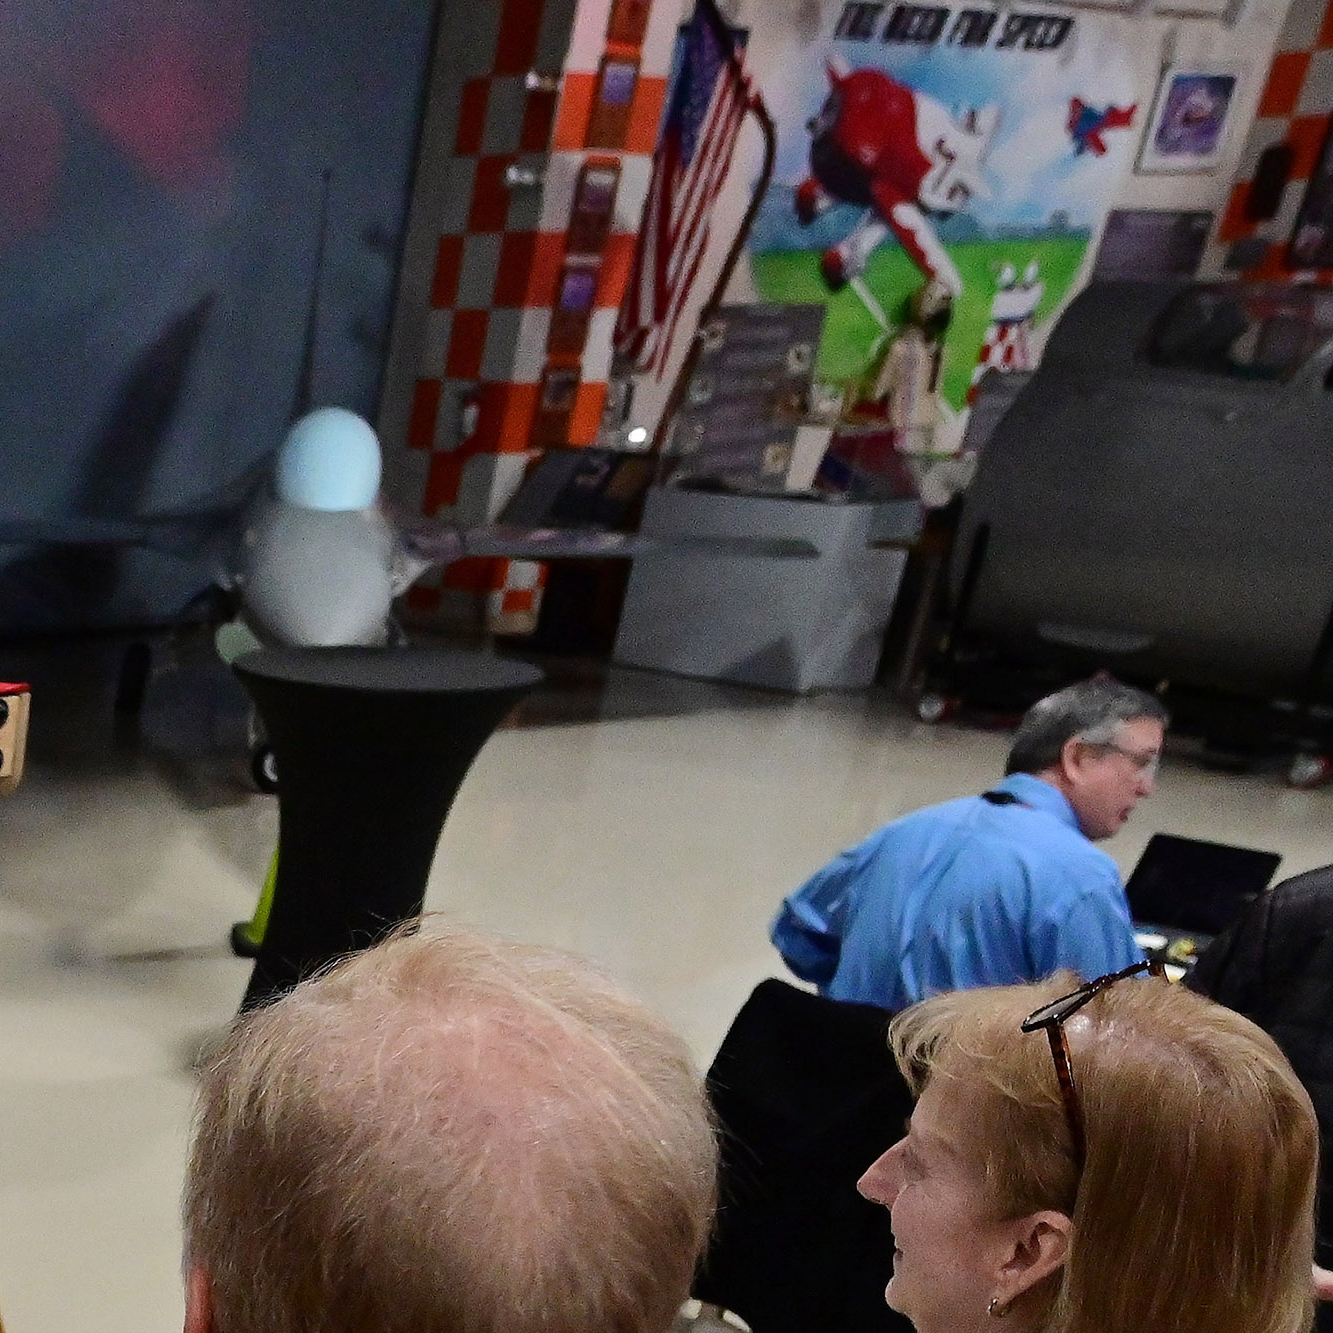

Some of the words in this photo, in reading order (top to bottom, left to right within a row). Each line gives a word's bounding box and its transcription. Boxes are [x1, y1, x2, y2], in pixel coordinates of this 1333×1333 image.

[834, 2, 886, 42] THE
[883, 6, 951, 45] NEED
[947, 10, 998, 48] FOR
[995, 13, 1075, 50] SPEED
